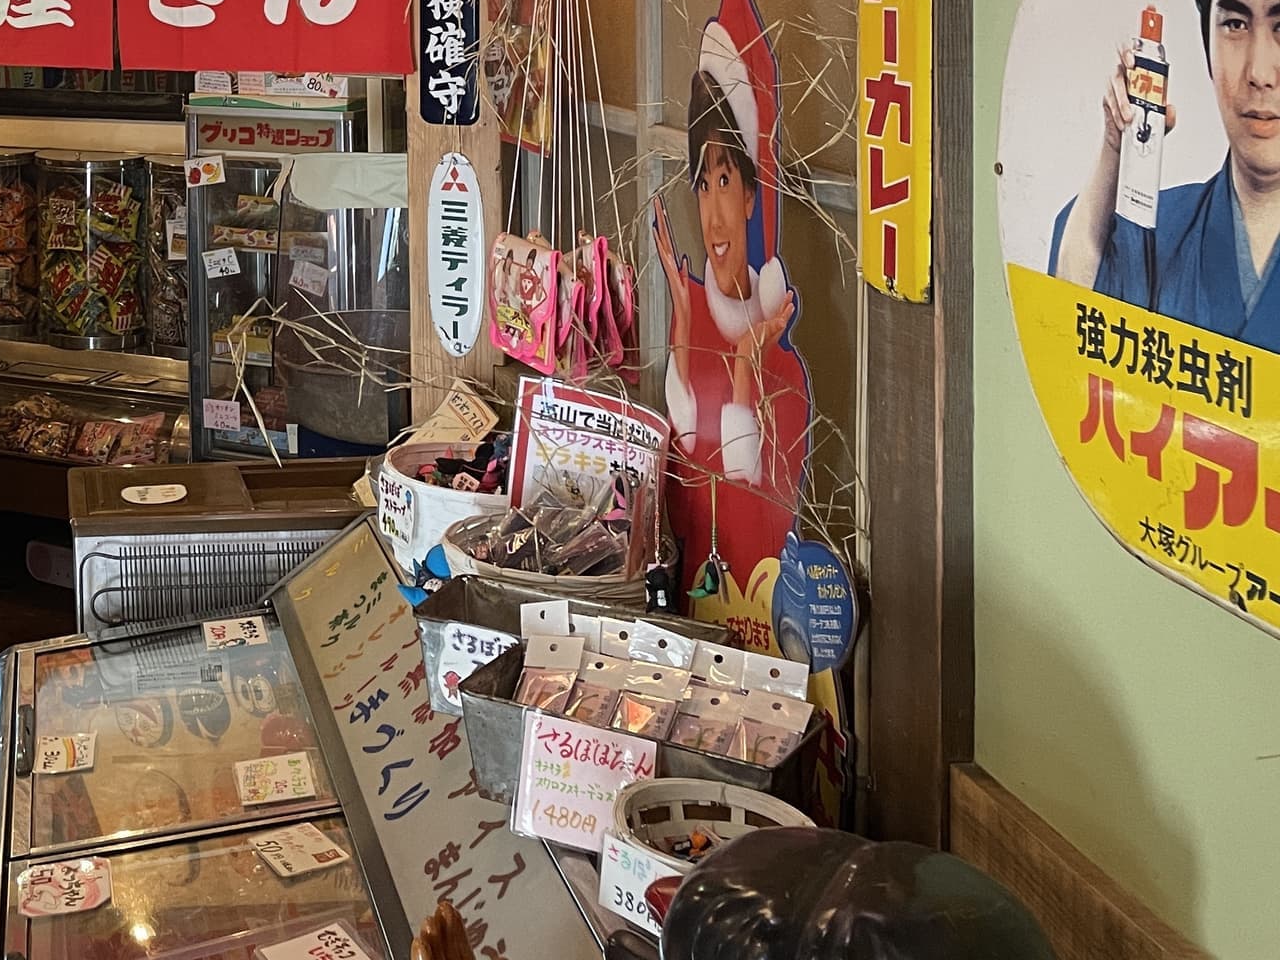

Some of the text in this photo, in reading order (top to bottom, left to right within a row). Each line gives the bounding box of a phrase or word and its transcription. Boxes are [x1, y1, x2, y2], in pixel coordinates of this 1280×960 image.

[199, 120, 335, 148] グリコ特選ショップ
[439, 199, 470, 341] 三菱ティラー
[1075, 302, 1252, 419] 強力殺虫剤
